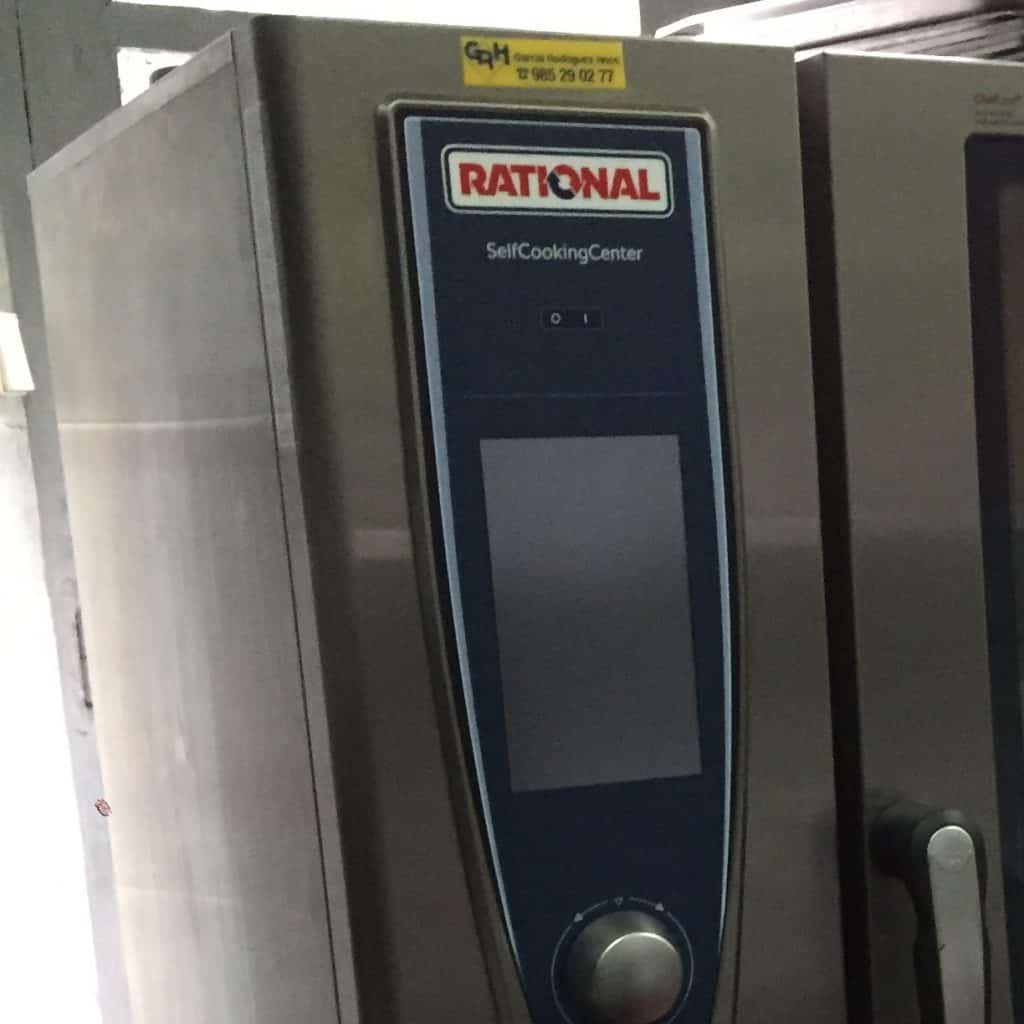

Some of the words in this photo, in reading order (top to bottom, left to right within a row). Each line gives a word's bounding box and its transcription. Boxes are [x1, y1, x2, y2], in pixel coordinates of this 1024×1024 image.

[559, 68, 575, 82] 29
[579, 68, 594, 82] 02
[598, 69, 614, 82] 77
[458, 162, 661, 201] RATIONAL
[486, 242, 643, 264] SelfCookingCenter
